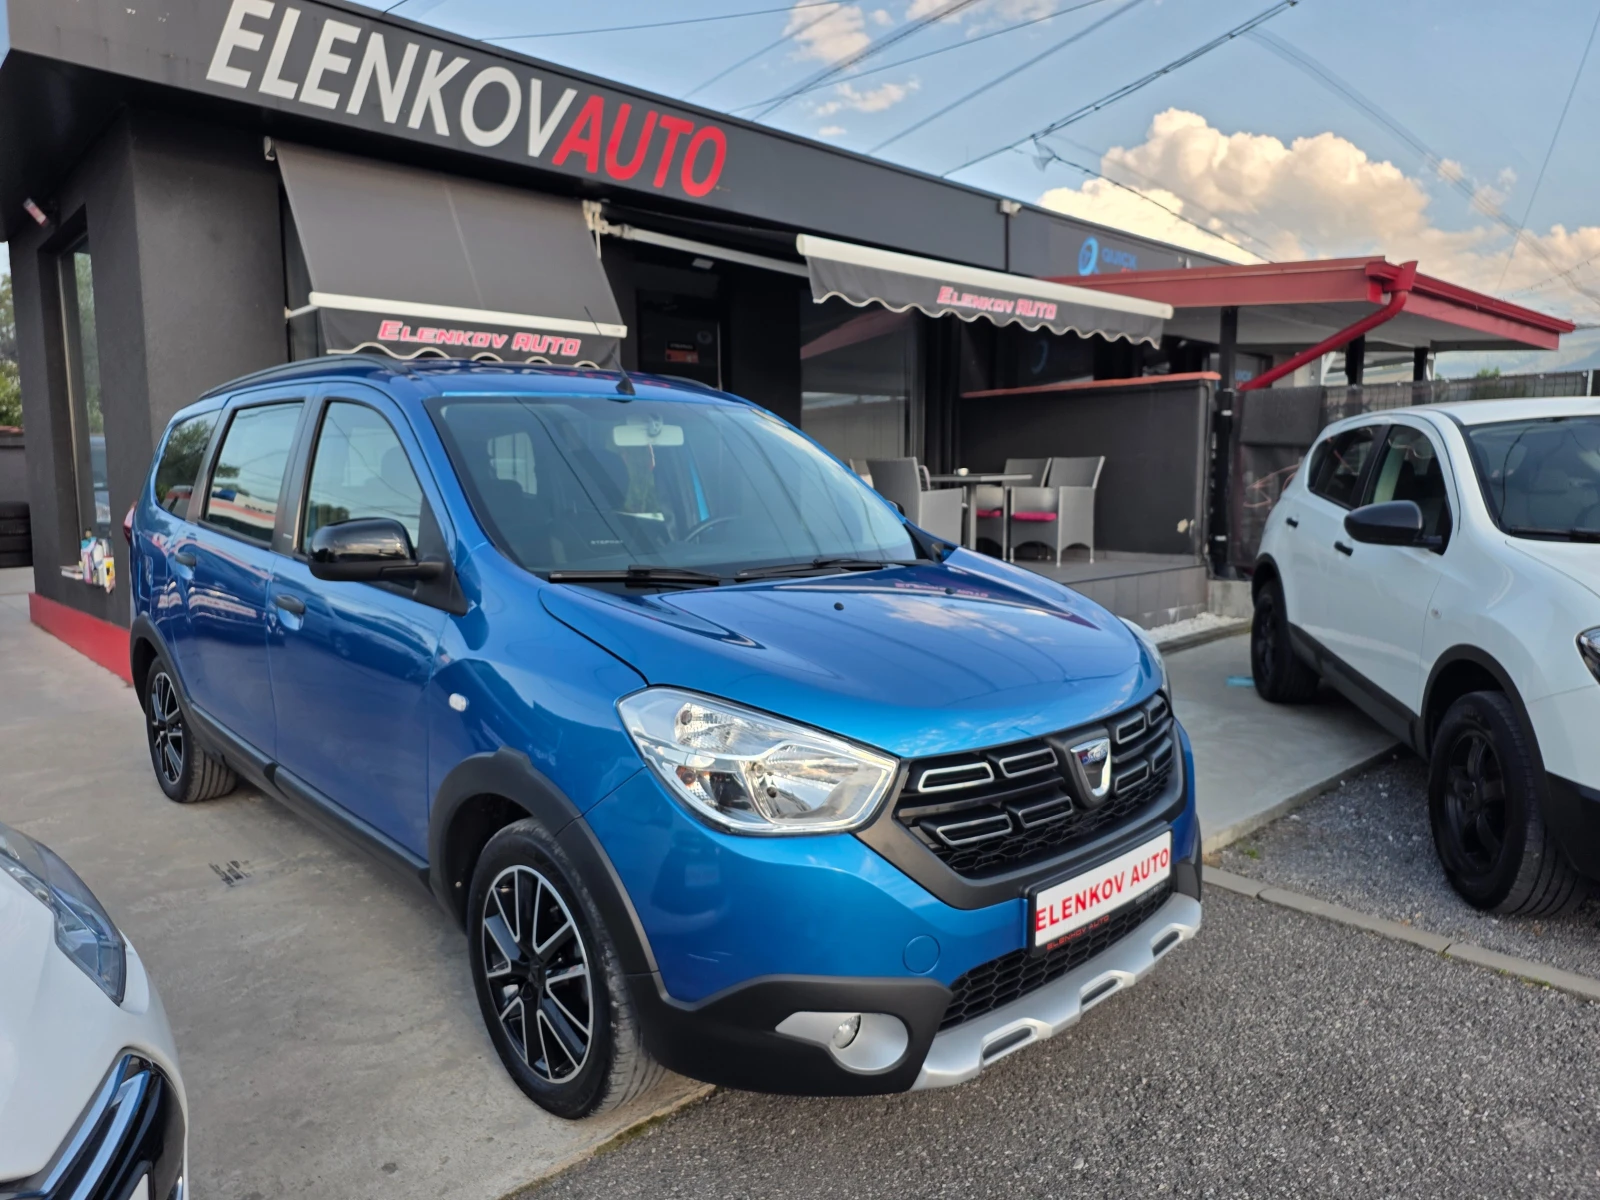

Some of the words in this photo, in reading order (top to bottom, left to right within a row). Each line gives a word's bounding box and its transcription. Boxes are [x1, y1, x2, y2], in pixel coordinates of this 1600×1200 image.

[206, 0, 578, 158] ELENKOV
[552, 95, 727, 198] AUTO
[936, 286, 1014, 314] ELENKOV
[1015, 299, 1058, 320] AUTO
[377, 319, 509, 349] ELENKOV
[511, 332, 582, 356] AUTO
[1035, 871, 1125, 932] ELENKOV
[1130, 847, 1169, 887] AUTO
